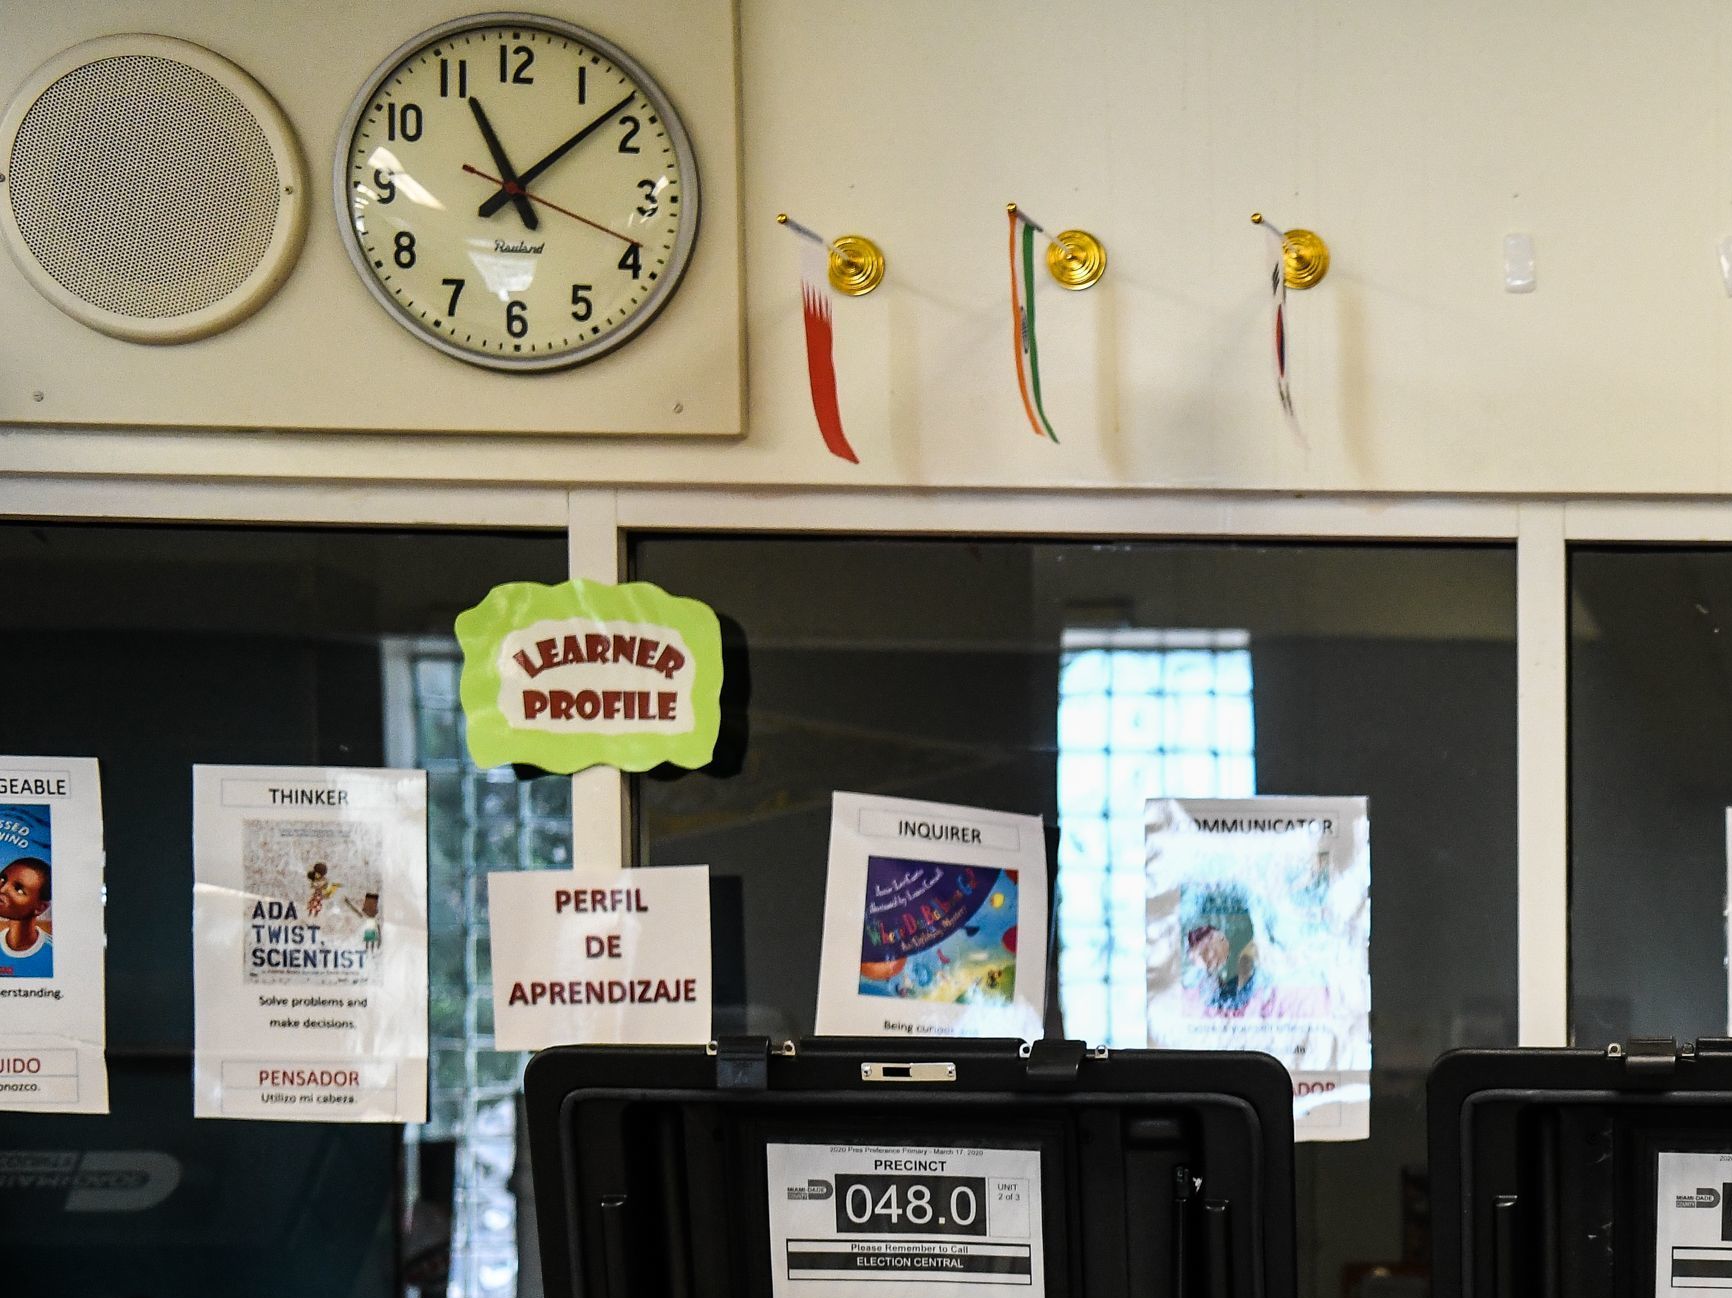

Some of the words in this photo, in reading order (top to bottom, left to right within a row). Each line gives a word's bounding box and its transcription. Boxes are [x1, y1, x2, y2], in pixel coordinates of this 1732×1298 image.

[440, 58, 467, 98] 11
[500, 44, 535, 85] 12
[578, 66, 587, 104] 1
[388, 103, 423, 142] 10
[618, 115, 641, 154] 2
[374, 168, 396, 204] 9
[636, 179, 659, 217] 3
[394, 231, 416, 269] 8
[617, 243, 642, 280] 4
[442, 278, 466, 317] 7
[571, 284, 593, 322] 5
[506, 300, 528, 339] 6
[512, 633, 686, 680] LEARNER
[522, 689, 679, 722] PROFILE
[268, 788, 350, 806] THINKER
[898, 820, 983, 845] INQUIRER
[251, 900, 299, 921] ADA
[554, 887, 649, 914] PERFIL
[251, 924, 326, 946] TWIST,
[585, 934, 622, 959] DE
[251, 947, 368, 969] SCIENTIST
[259, 996, 289, 1007] Solve
[291, 996, 344, 1009] problems
[346, 997, 368, 1008] and
[508, 978, 697, 1007] APRENDIZAJE
[269, 1018, 300, 1029] make
[303, 1018, 357, 1030] decisions.
[883, 1020, 914, 1034] Being
[258, 1069, 361, 1087] PENSADOR
[299, 1093, 314, 1104] mi
[873, 1158, 948, 1173] PRECINCT
[997, 1183, 1019, 1192] UNIT
[1004, 1193, 1014, 1201] of
[1015, 1194, 1021, 1202] 3
[844, 1183, 978, 1227] 048.0
[850, 1243, 883, 1254] Please
[885, 1244, 937, 1255] Remember
[938, 1244, 949, 1255] to
[950, 1245, 969, 1255] Call
[856, 1256, 911, 1268] ELECTION
[914, 1257, 965, 1269] CENTRAL
